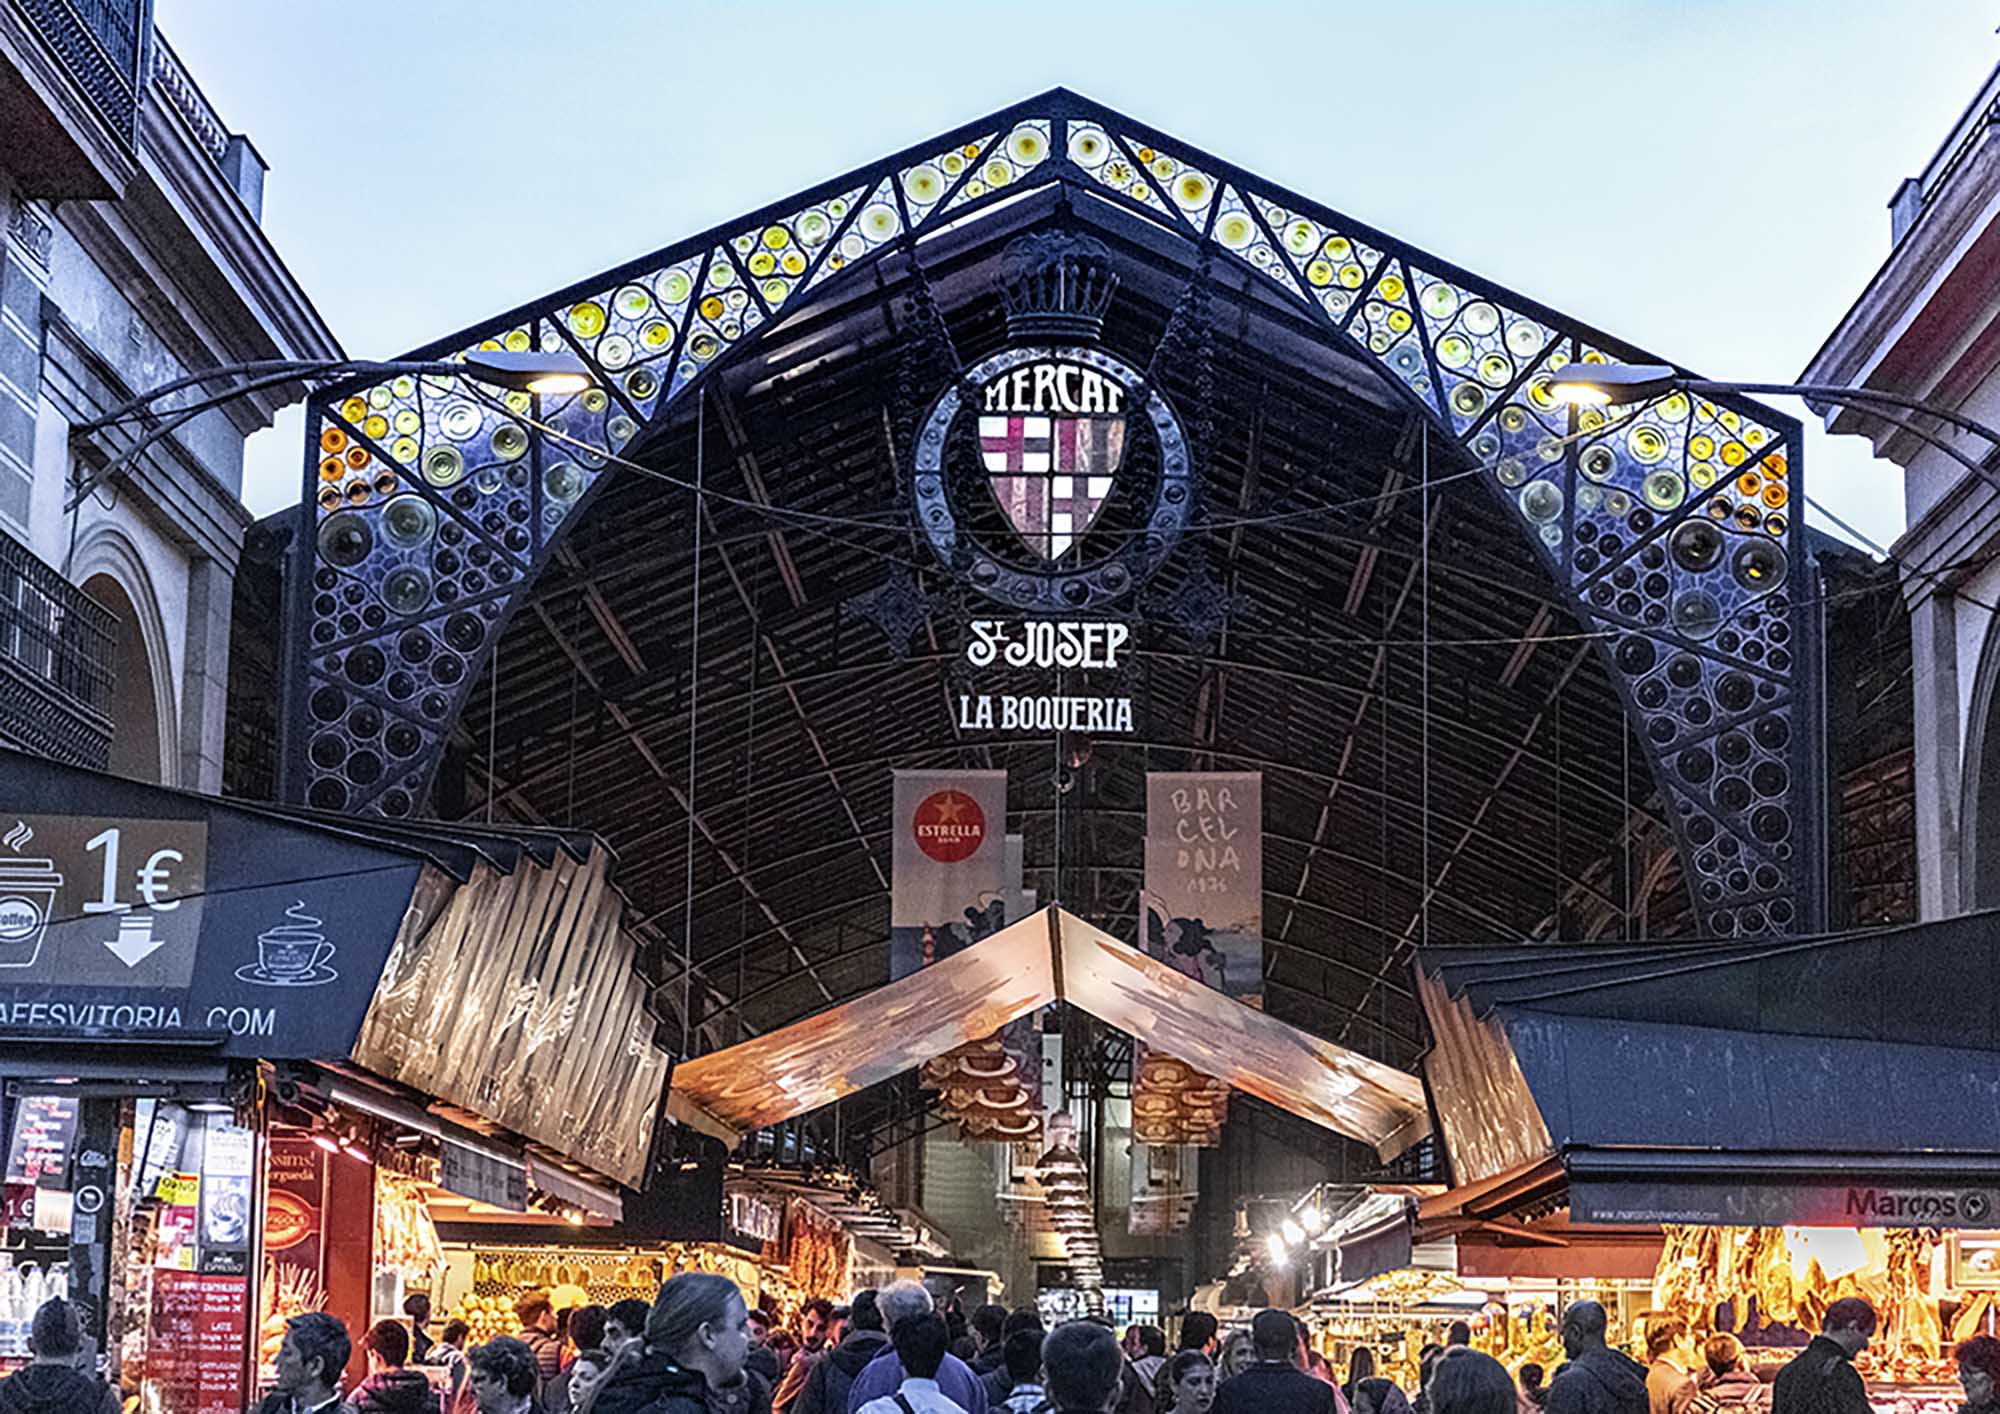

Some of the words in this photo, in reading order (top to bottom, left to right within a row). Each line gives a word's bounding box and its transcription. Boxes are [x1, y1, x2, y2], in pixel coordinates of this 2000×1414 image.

[984, 363, 1125, 413] MERCAT
[1004, 621, 1128, 668] JOSEP
[959, 694, 992, 729] LA
[1001, 695, 1134, 732] BOQUERIA
[1170, 786, 1239, 814] BAR
[917, 824, 981, 837] ESTRELLA
[1845, 1187, 1956, 1217] Marcos
